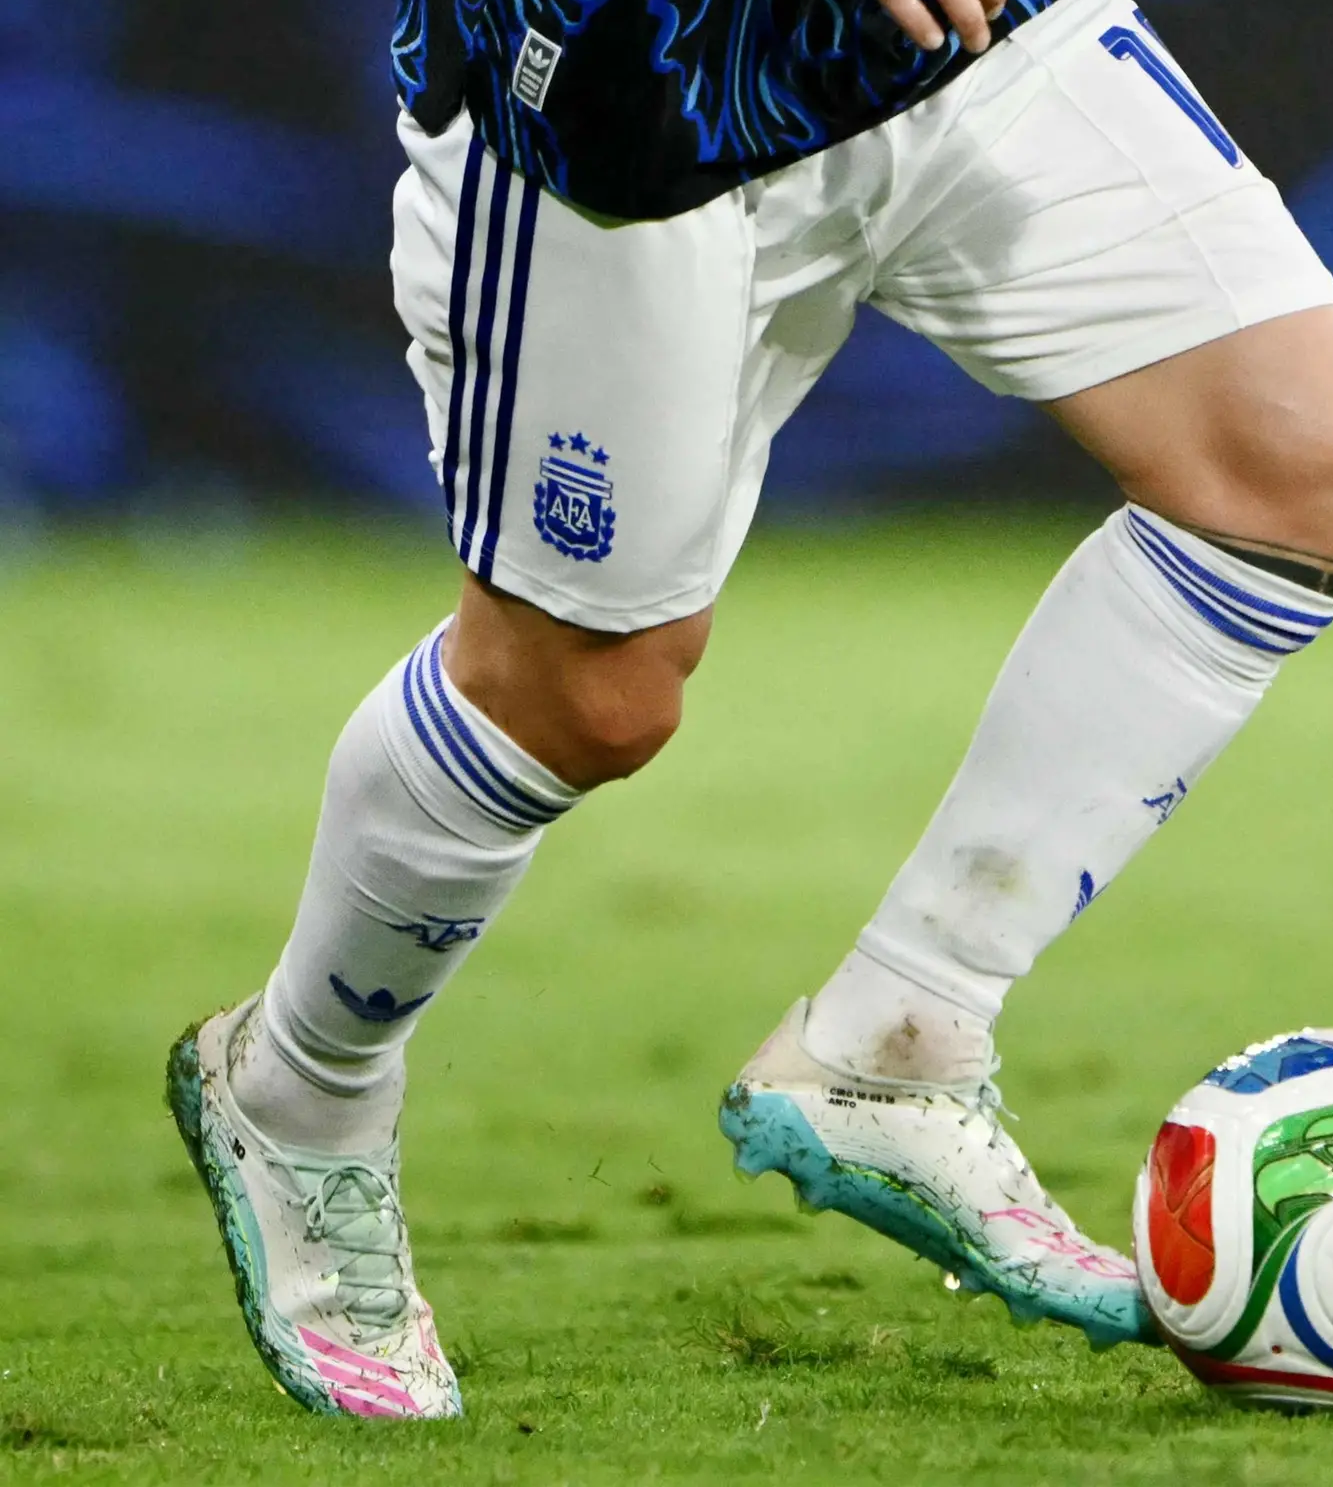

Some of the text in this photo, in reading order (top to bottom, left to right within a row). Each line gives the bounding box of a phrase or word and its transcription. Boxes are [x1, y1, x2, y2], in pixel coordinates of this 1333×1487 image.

[1097, 7, 1244, 169] 1
[548, 484, 596, 535] AFA
[828, 1097, 857, 1109] ANTO
